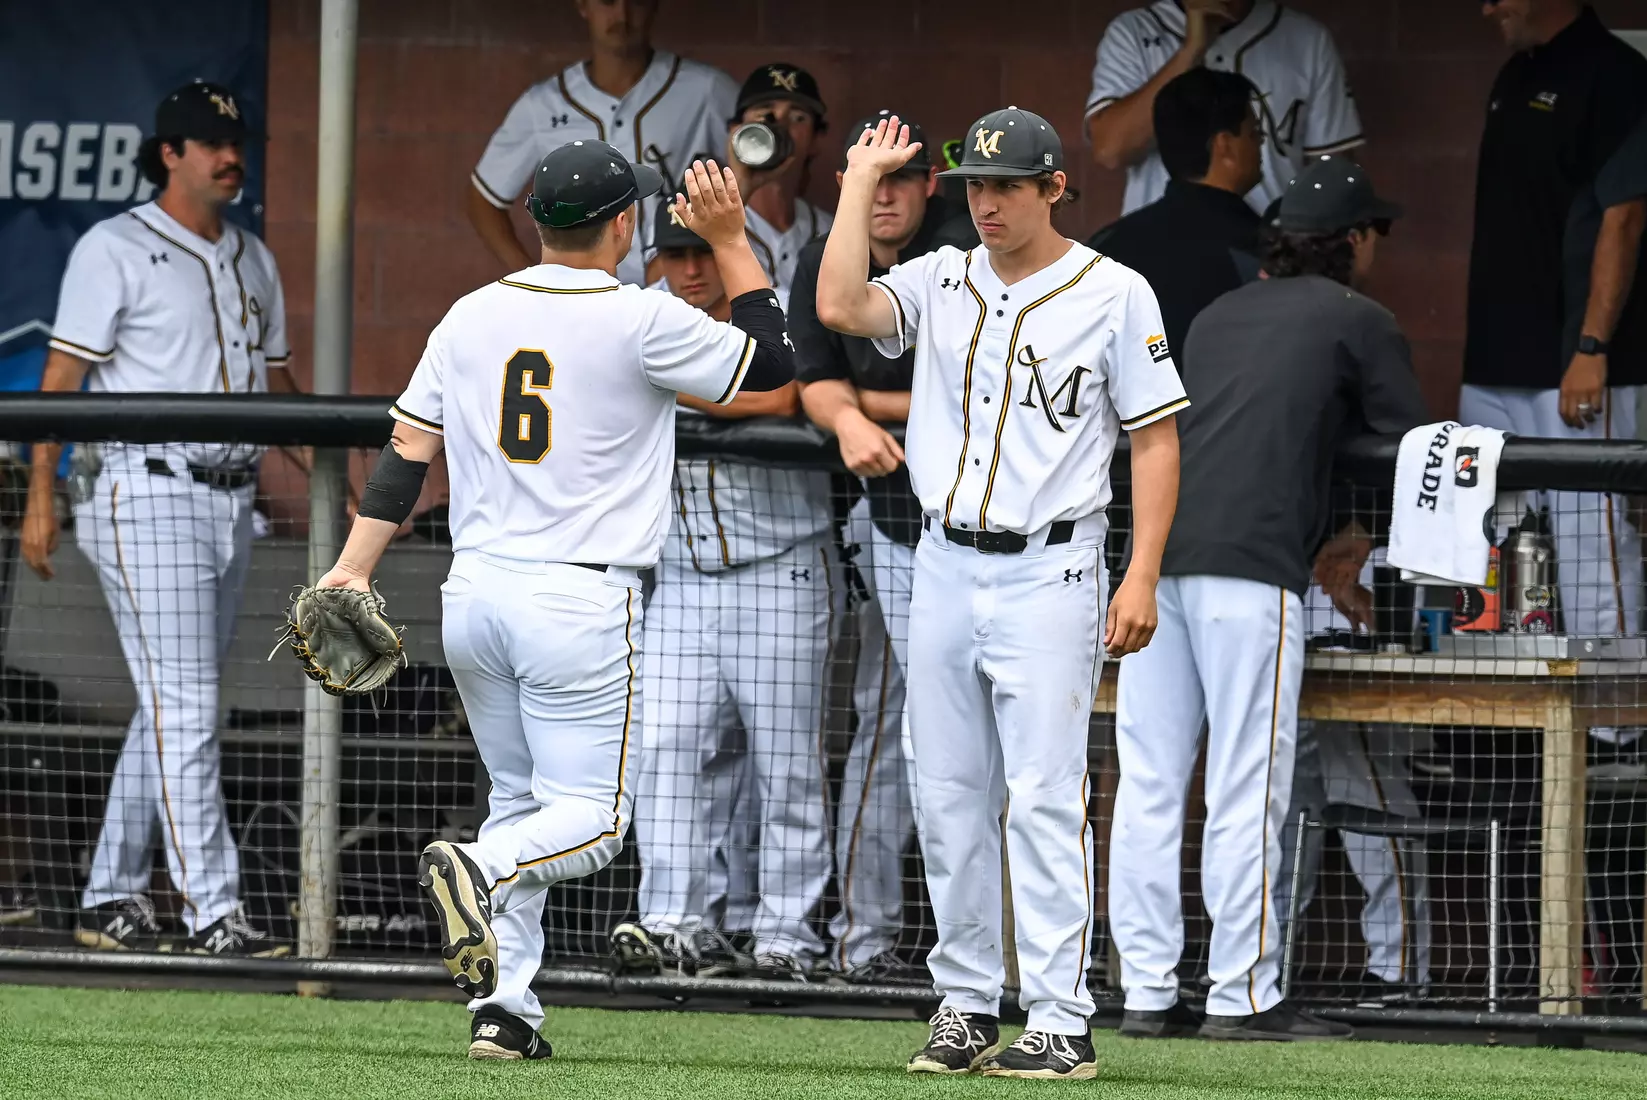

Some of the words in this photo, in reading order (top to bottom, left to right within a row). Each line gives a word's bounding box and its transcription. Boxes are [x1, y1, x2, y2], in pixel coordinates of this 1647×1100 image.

[974, 127, 1005, 159] M
[497, 347, 555, 465] 6
[1018, 345, 1092, 432] M
